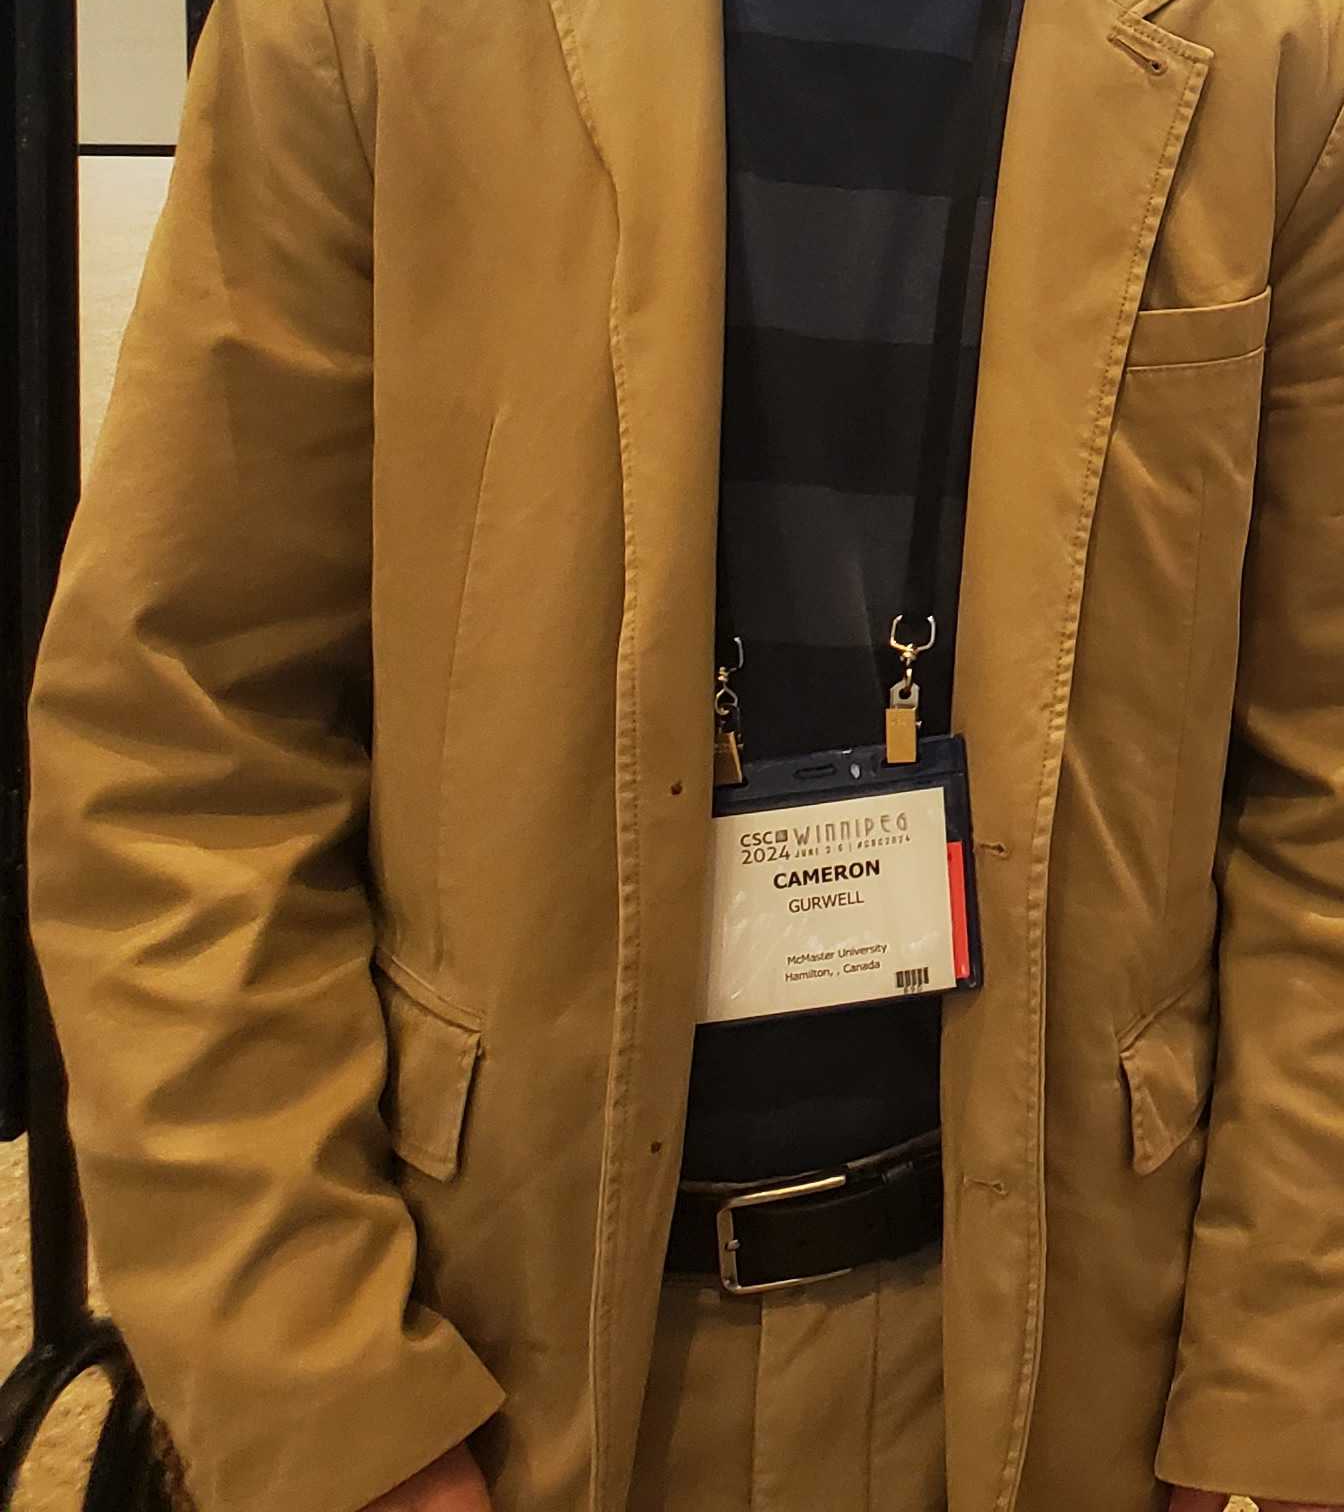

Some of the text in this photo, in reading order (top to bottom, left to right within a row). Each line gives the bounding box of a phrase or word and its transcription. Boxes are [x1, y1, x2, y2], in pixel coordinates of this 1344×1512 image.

[740, 830, 773, 847] CSC
[741, 845, 790, 865] 2024
[773, 859, 881, 889] CAMERON
[788, 891, 865, 913] GURWELL
[787, 943, 888, 966] McMaster University
[843, 960, 881, 974] Canada
